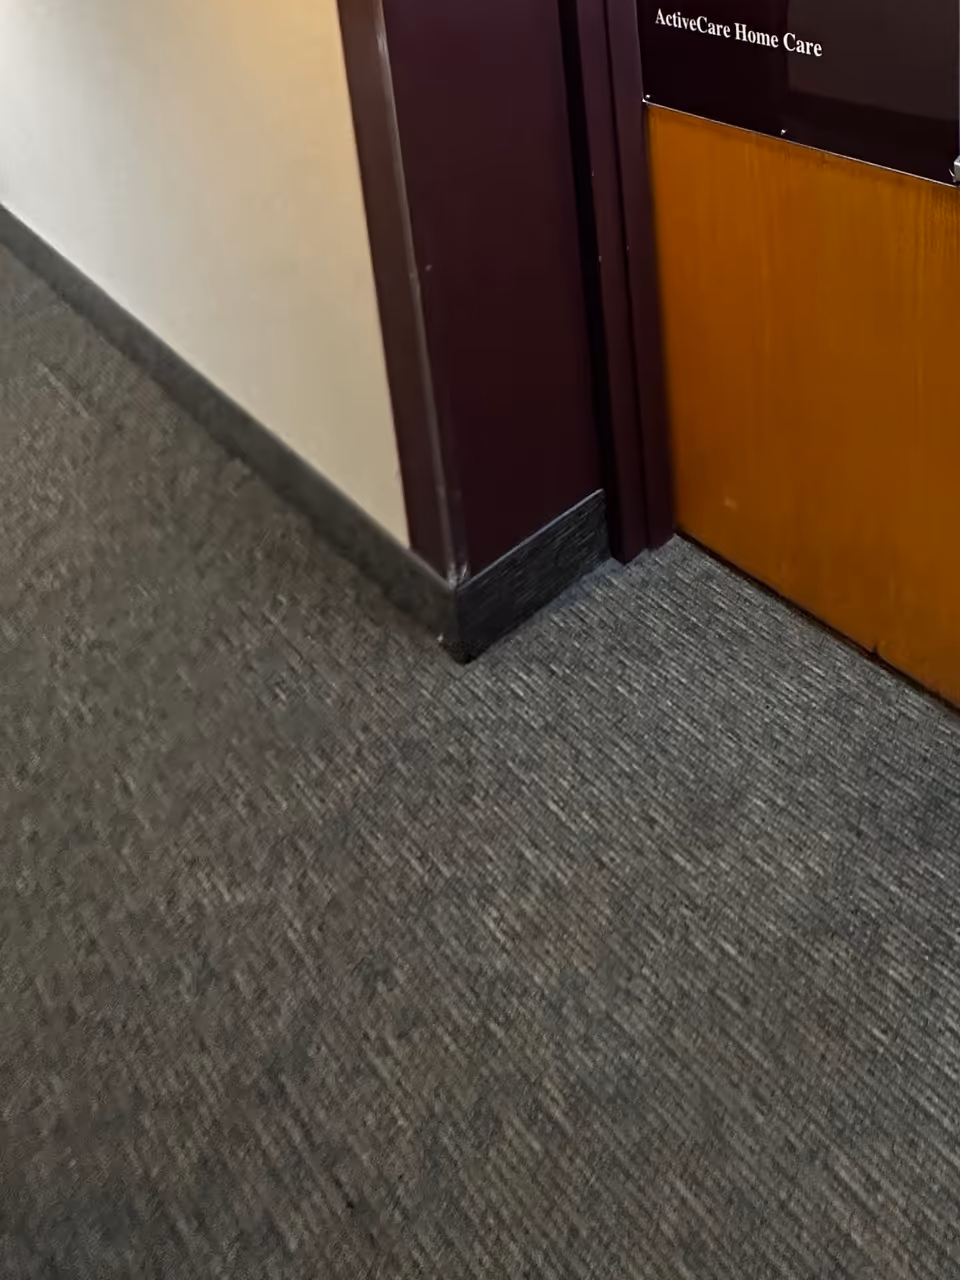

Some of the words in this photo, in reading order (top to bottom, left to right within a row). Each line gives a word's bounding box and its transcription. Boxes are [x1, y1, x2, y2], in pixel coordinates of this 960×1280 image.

[655, 8, 731, 38] ActiveCare
[734, 22, 779, 48] Home
[783, 32, 823, 57] Care
